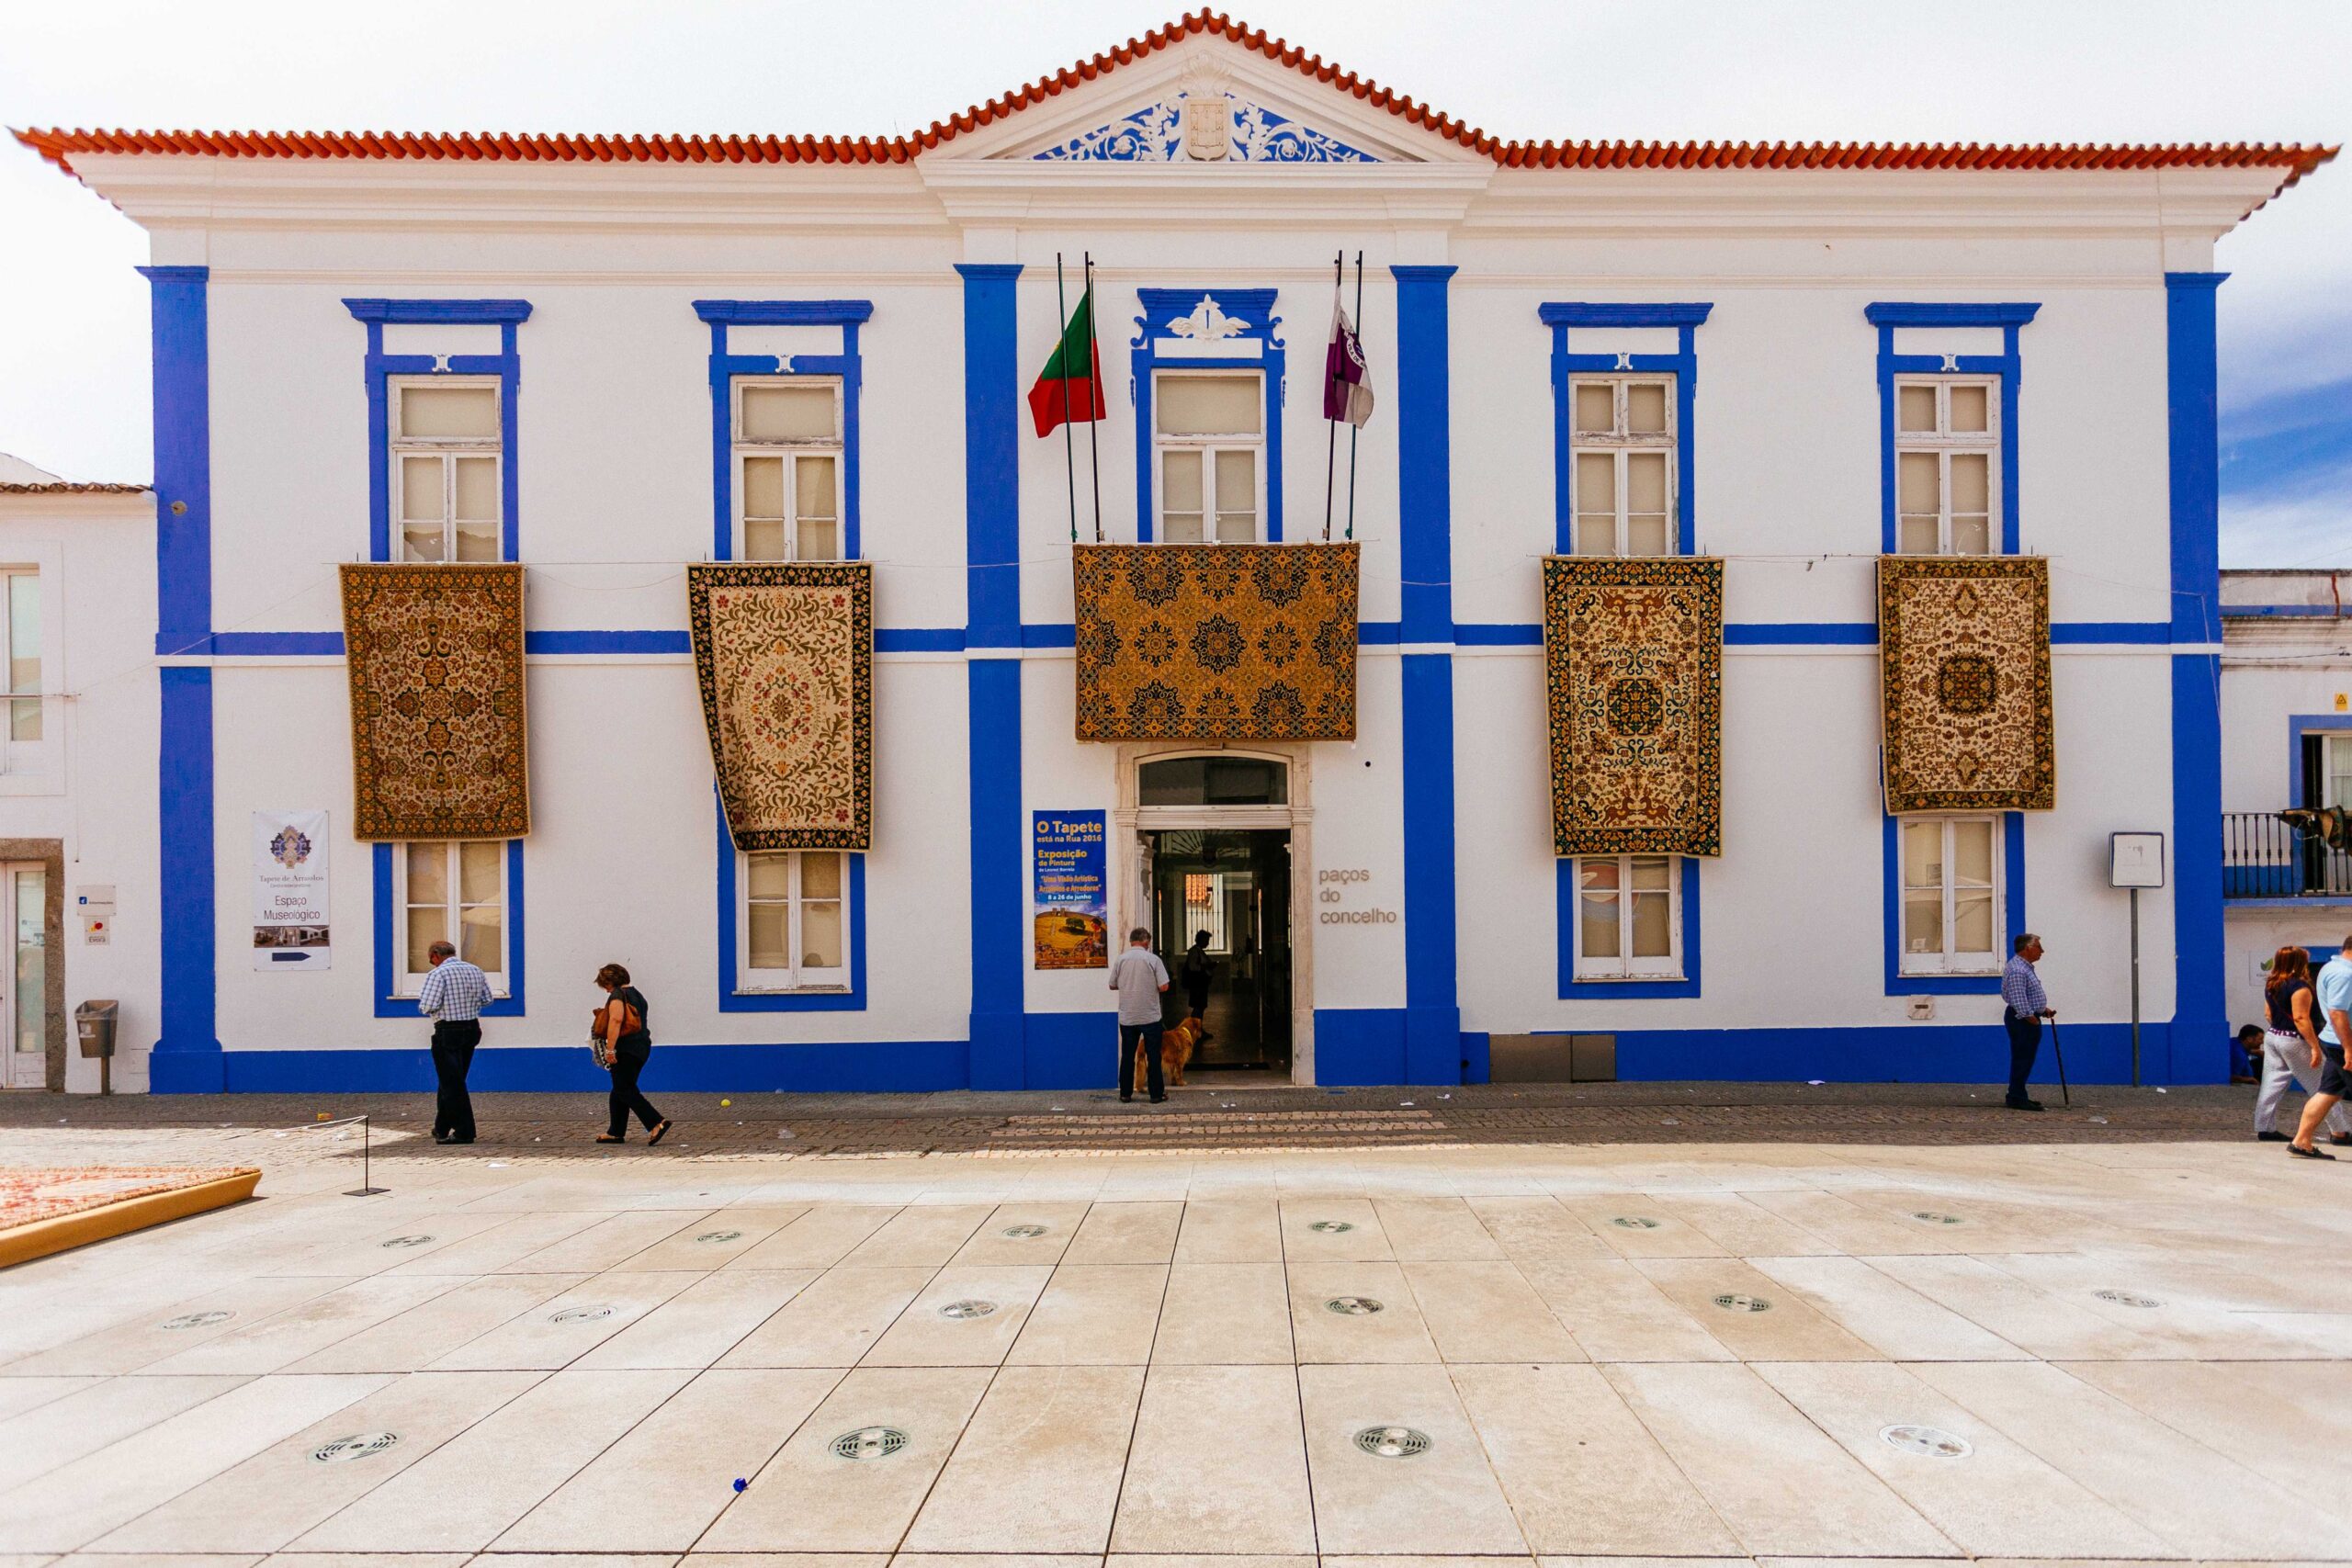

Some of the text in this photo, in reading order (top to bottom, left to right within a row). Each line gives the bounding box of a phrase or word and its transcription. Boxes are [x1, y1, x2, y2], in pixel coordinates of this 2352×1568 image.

[1036, 821, 1102, 835] O Tapete
[1066, 834, 1081, 842] Rua
[1082, 834, 1102, 842] 2016
[1038, 850, 1087, 860] Exposição
[1319, 869, 1370, 886] paços
[275, 895, 307, 908] Espaço
[1319, 887, 1340, 903] do
[264, 909, 321, 922] Museológico
[1320, 908, 1397, 924] concelho
